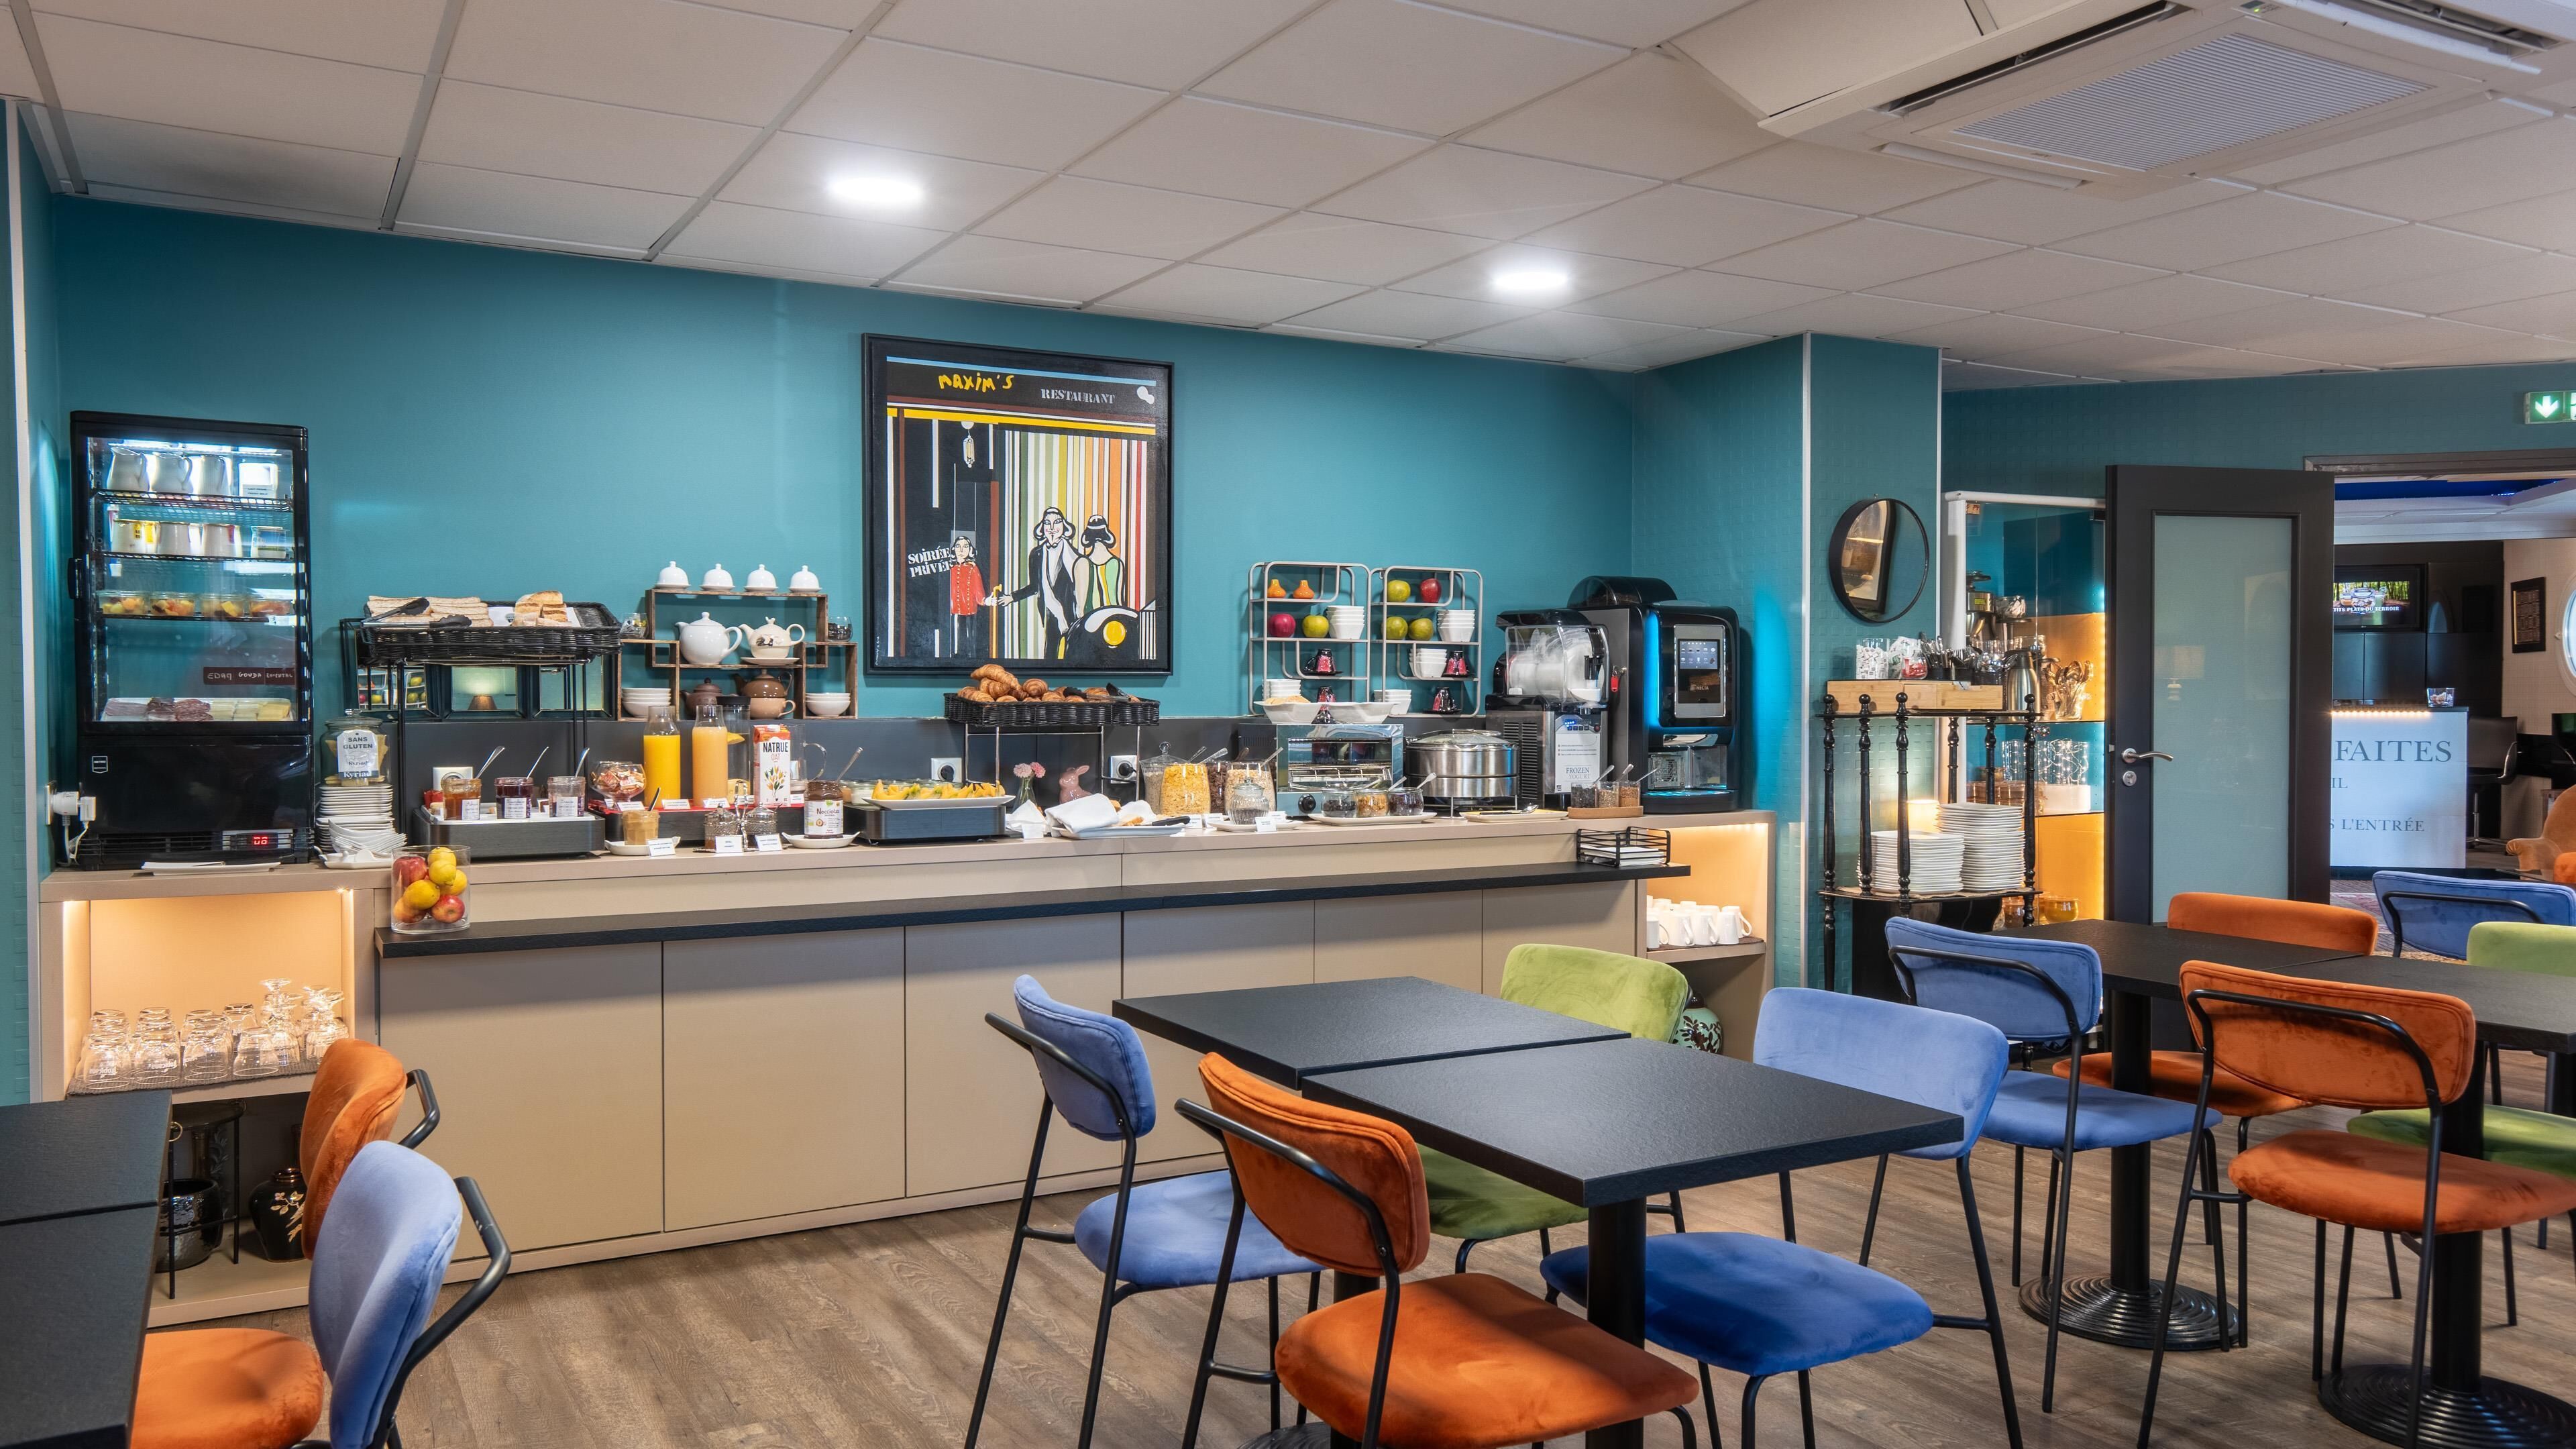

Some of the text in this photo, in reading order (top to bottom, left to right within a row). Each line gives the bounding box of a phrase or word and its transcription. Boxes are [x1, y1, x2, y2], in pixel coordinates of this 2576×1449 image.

[1040, 388, 1115, 404] RESTAURANT
[763, 742, 789, 753] NATRUE
[2334, 740, 2452, 763] FAITES
[771, 753, 780, 761] OAT
[2342, 816, 2424, 832] L'ENTRÉE
